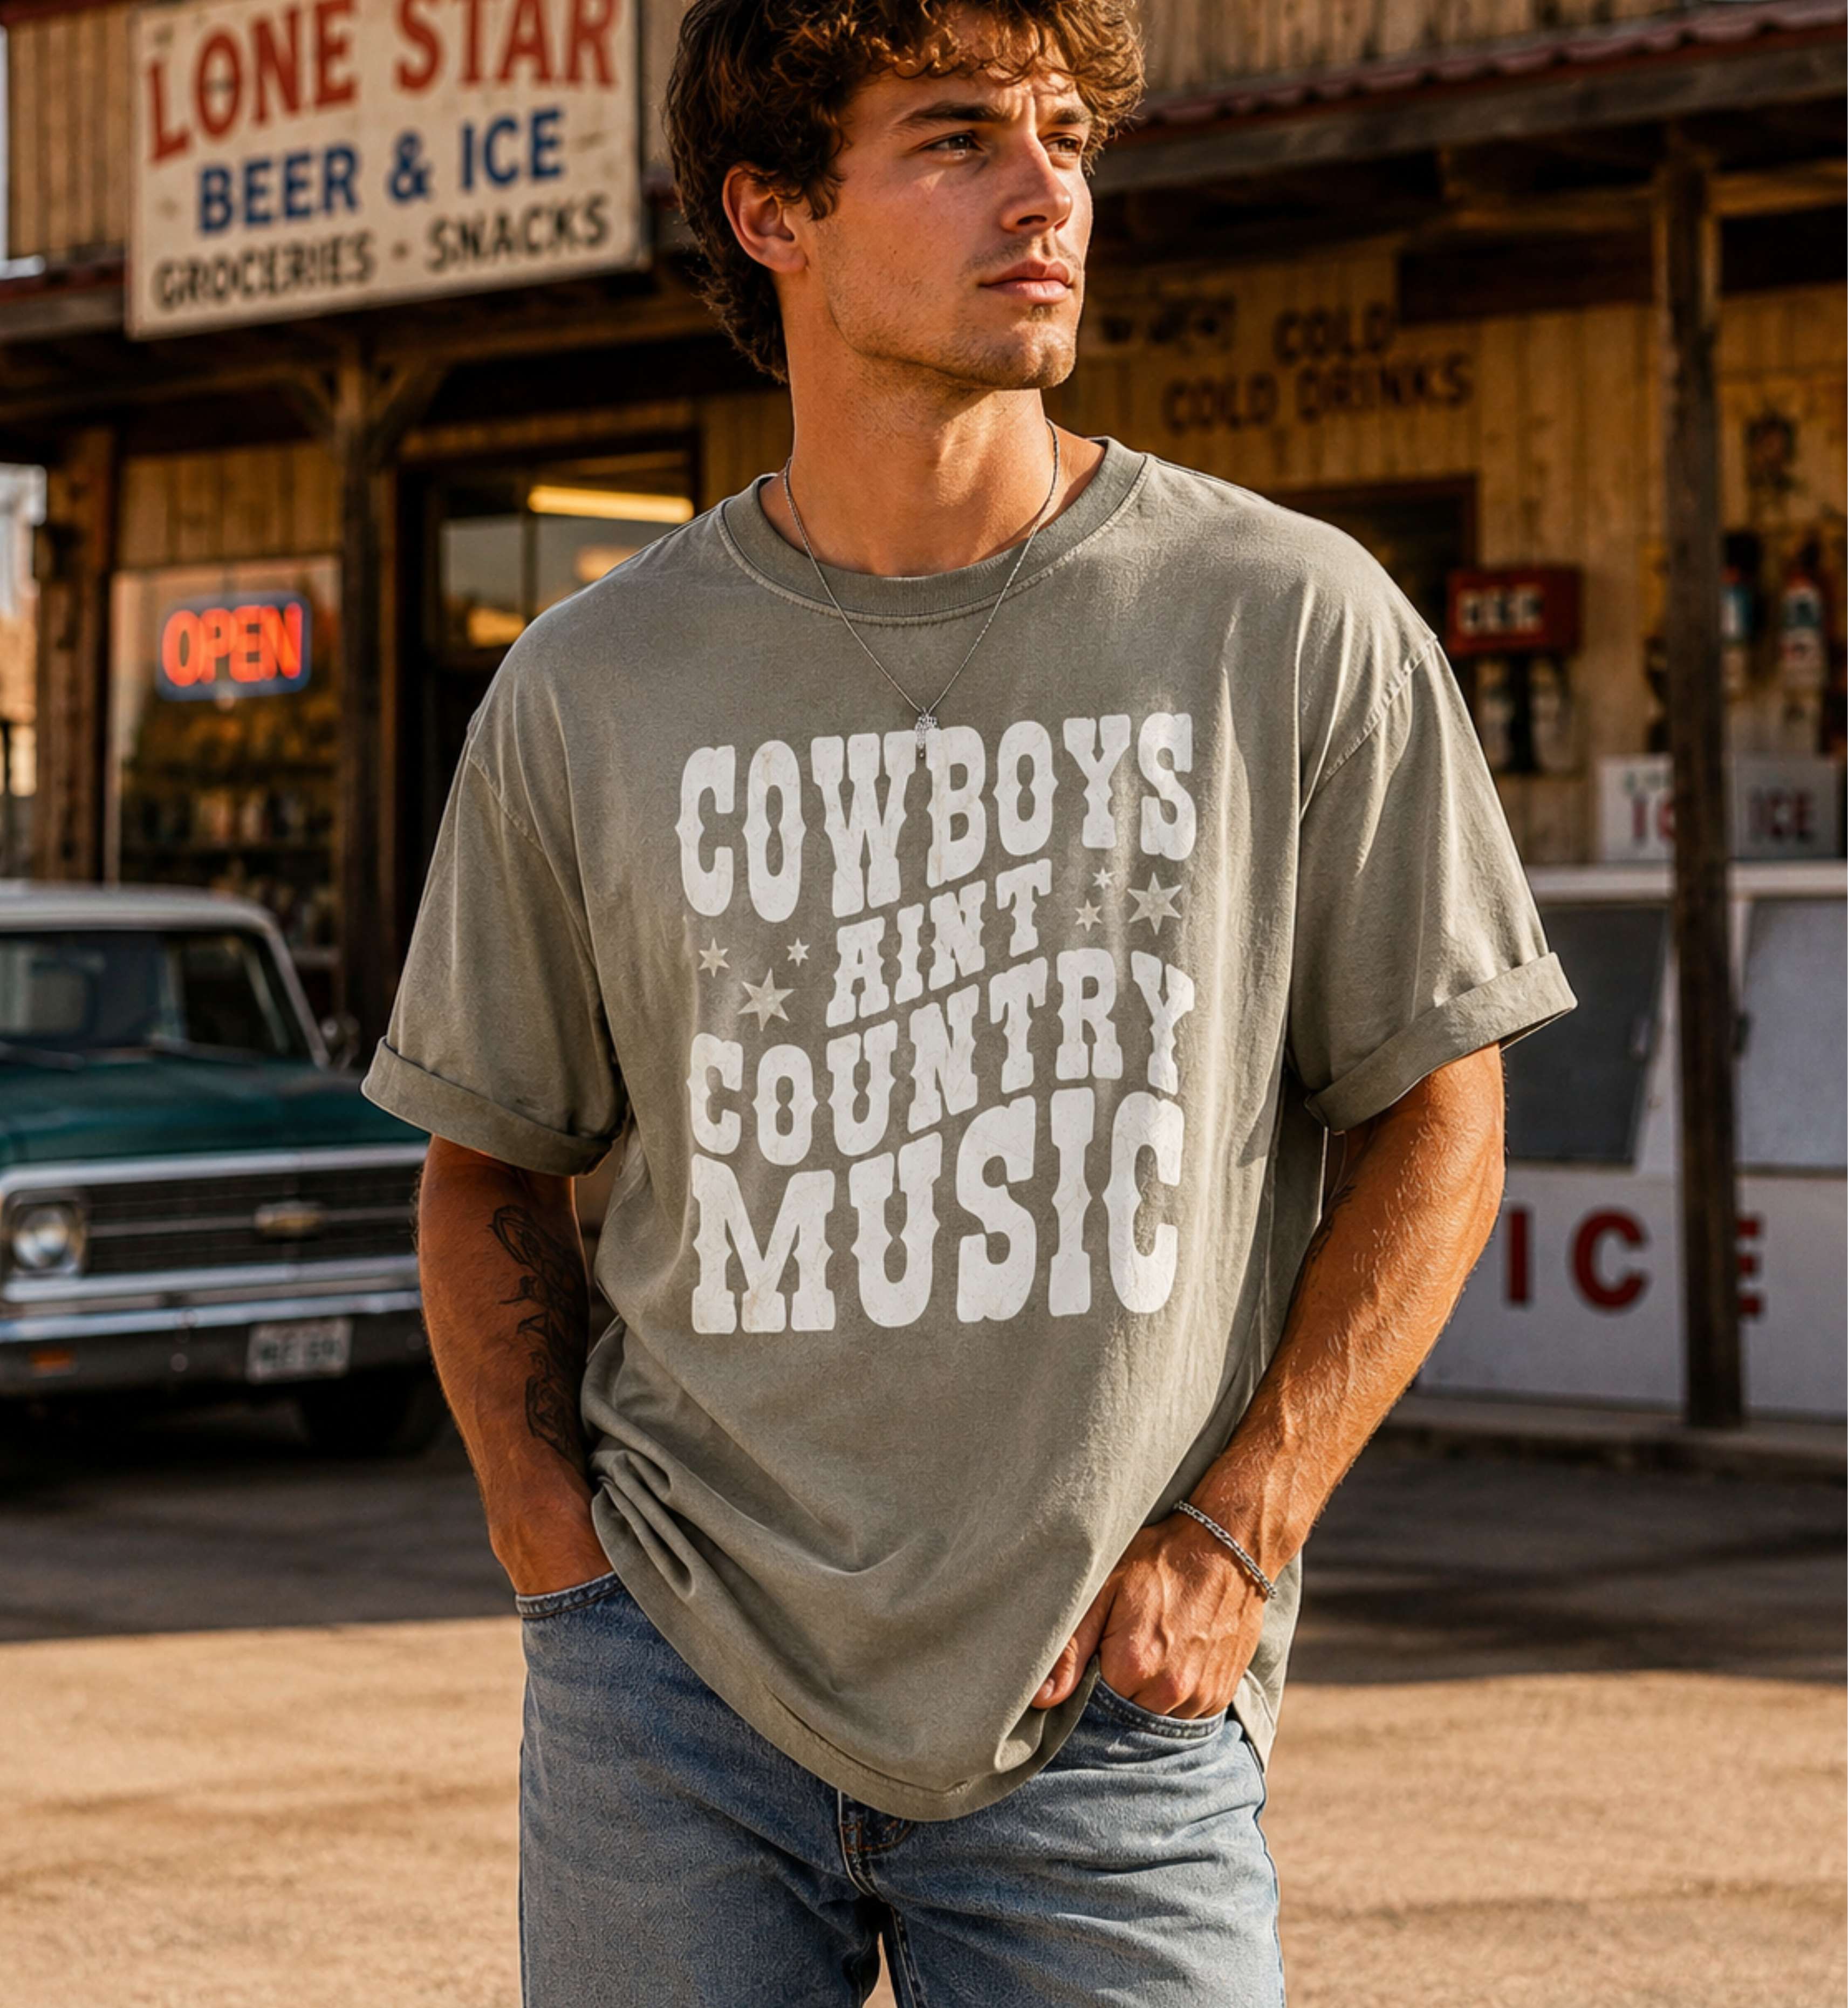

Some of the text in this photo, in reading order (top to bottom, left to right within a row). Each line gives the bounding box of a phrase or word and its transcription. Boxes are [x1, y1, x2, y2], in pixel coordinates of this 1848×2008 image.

[148, 0, 618, 164] LONE STAR
[153, 194, 609, 311] GROCERIES SNACKS
[198, 108, 564, 234] BEER & ICE
[1161, 352, 1473, 434] COLD DRINKS
[161, 602, 304, 687] OPEN
[675, 712, 1197, 923] COWBOYS
[825, 858, 1052, 1028] AINT
[686, 948, 1195, 1166] COUNTRY
[691, 1087, 1186, 1335] MUSIC
